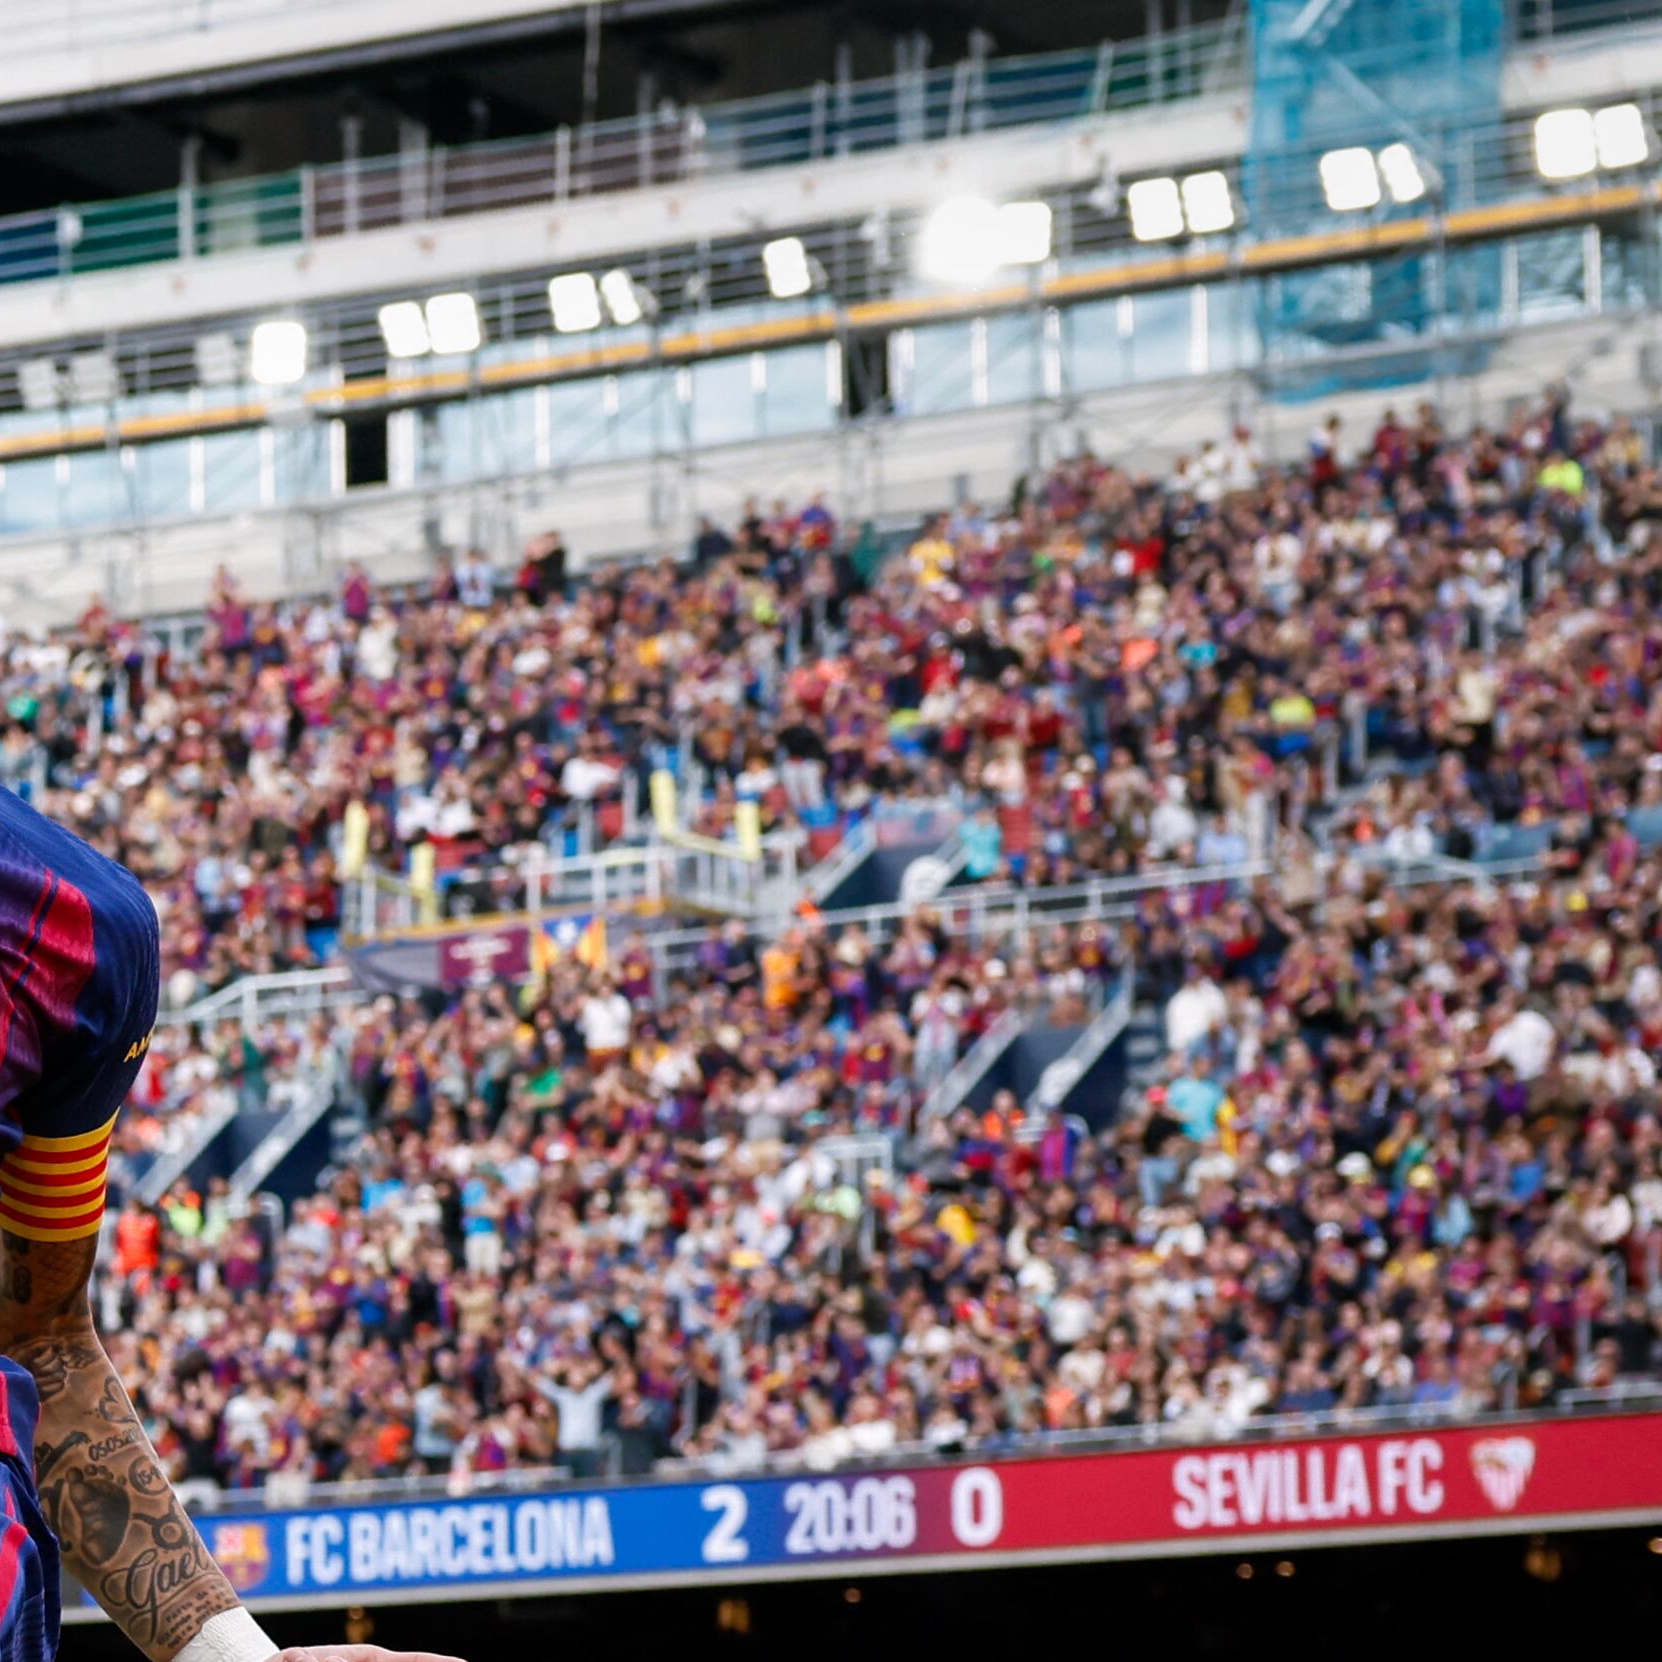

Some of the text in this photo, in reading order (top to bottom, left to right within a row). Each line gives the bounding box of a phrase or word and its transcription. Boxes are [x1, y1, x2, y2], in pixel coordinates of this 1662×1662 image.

[286, 1438, 1445, 1586] FC BARCELONA 2 20:06 0 SEVILLA FC
